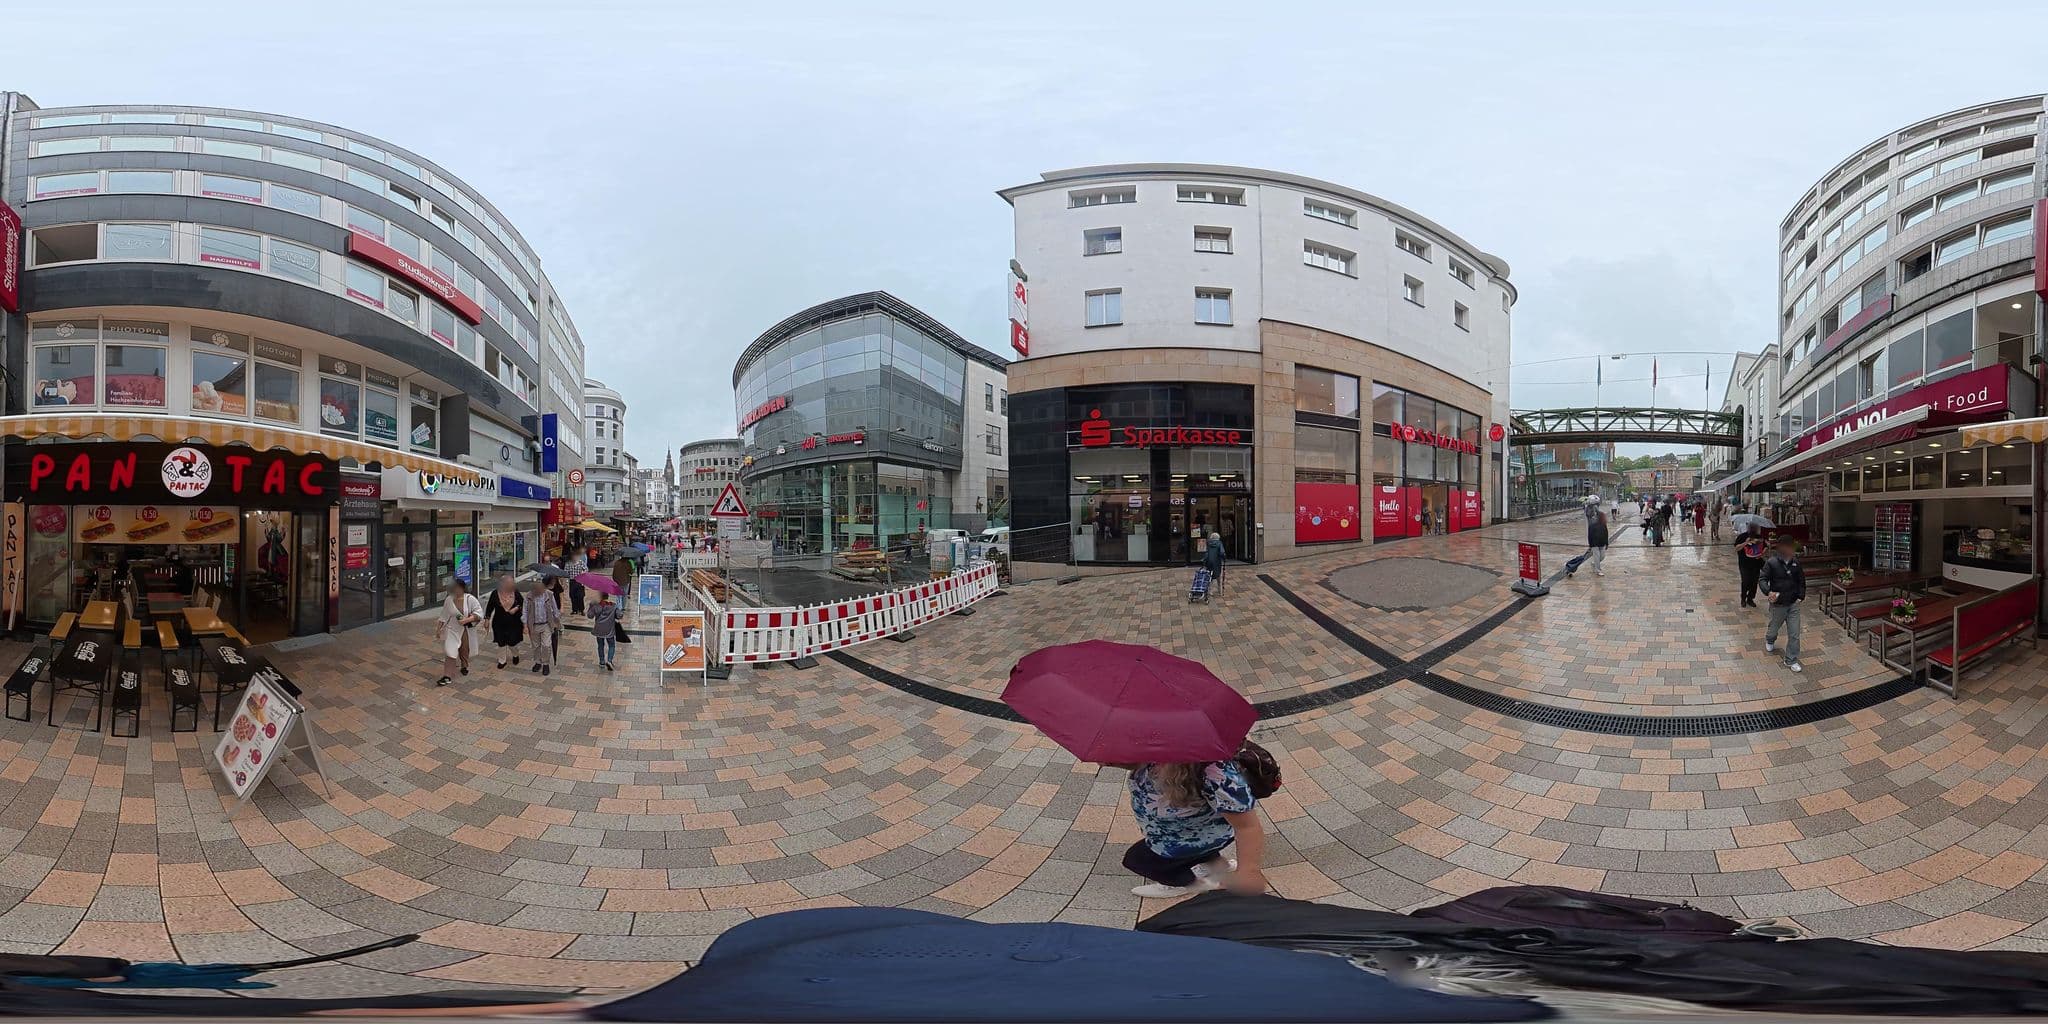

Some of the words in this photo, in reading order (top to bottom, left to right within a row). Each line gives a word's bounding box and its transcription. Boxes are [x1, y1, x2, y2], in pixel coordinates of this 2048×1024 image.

[397, 258, 449, 295] Studienkreis
[110, 326, 162, 334] PHOTOPIA
[257, 344, 297, 359] PHOTOPIA
[1948, 386, 1988, 410] Food
[1123, 424, 1242, 450] Sparkasse
[30, 452, 137, 492] PAN
[225, 455, 325, 496] TAC
[169, 481, 188, 491] PAN
[189, 482, 205, 491] TAC
[143, 510, 157, 519] 9.50
[1379, 500, 1400, 511] Hallo
[6, 514, 17, 553] PAN
